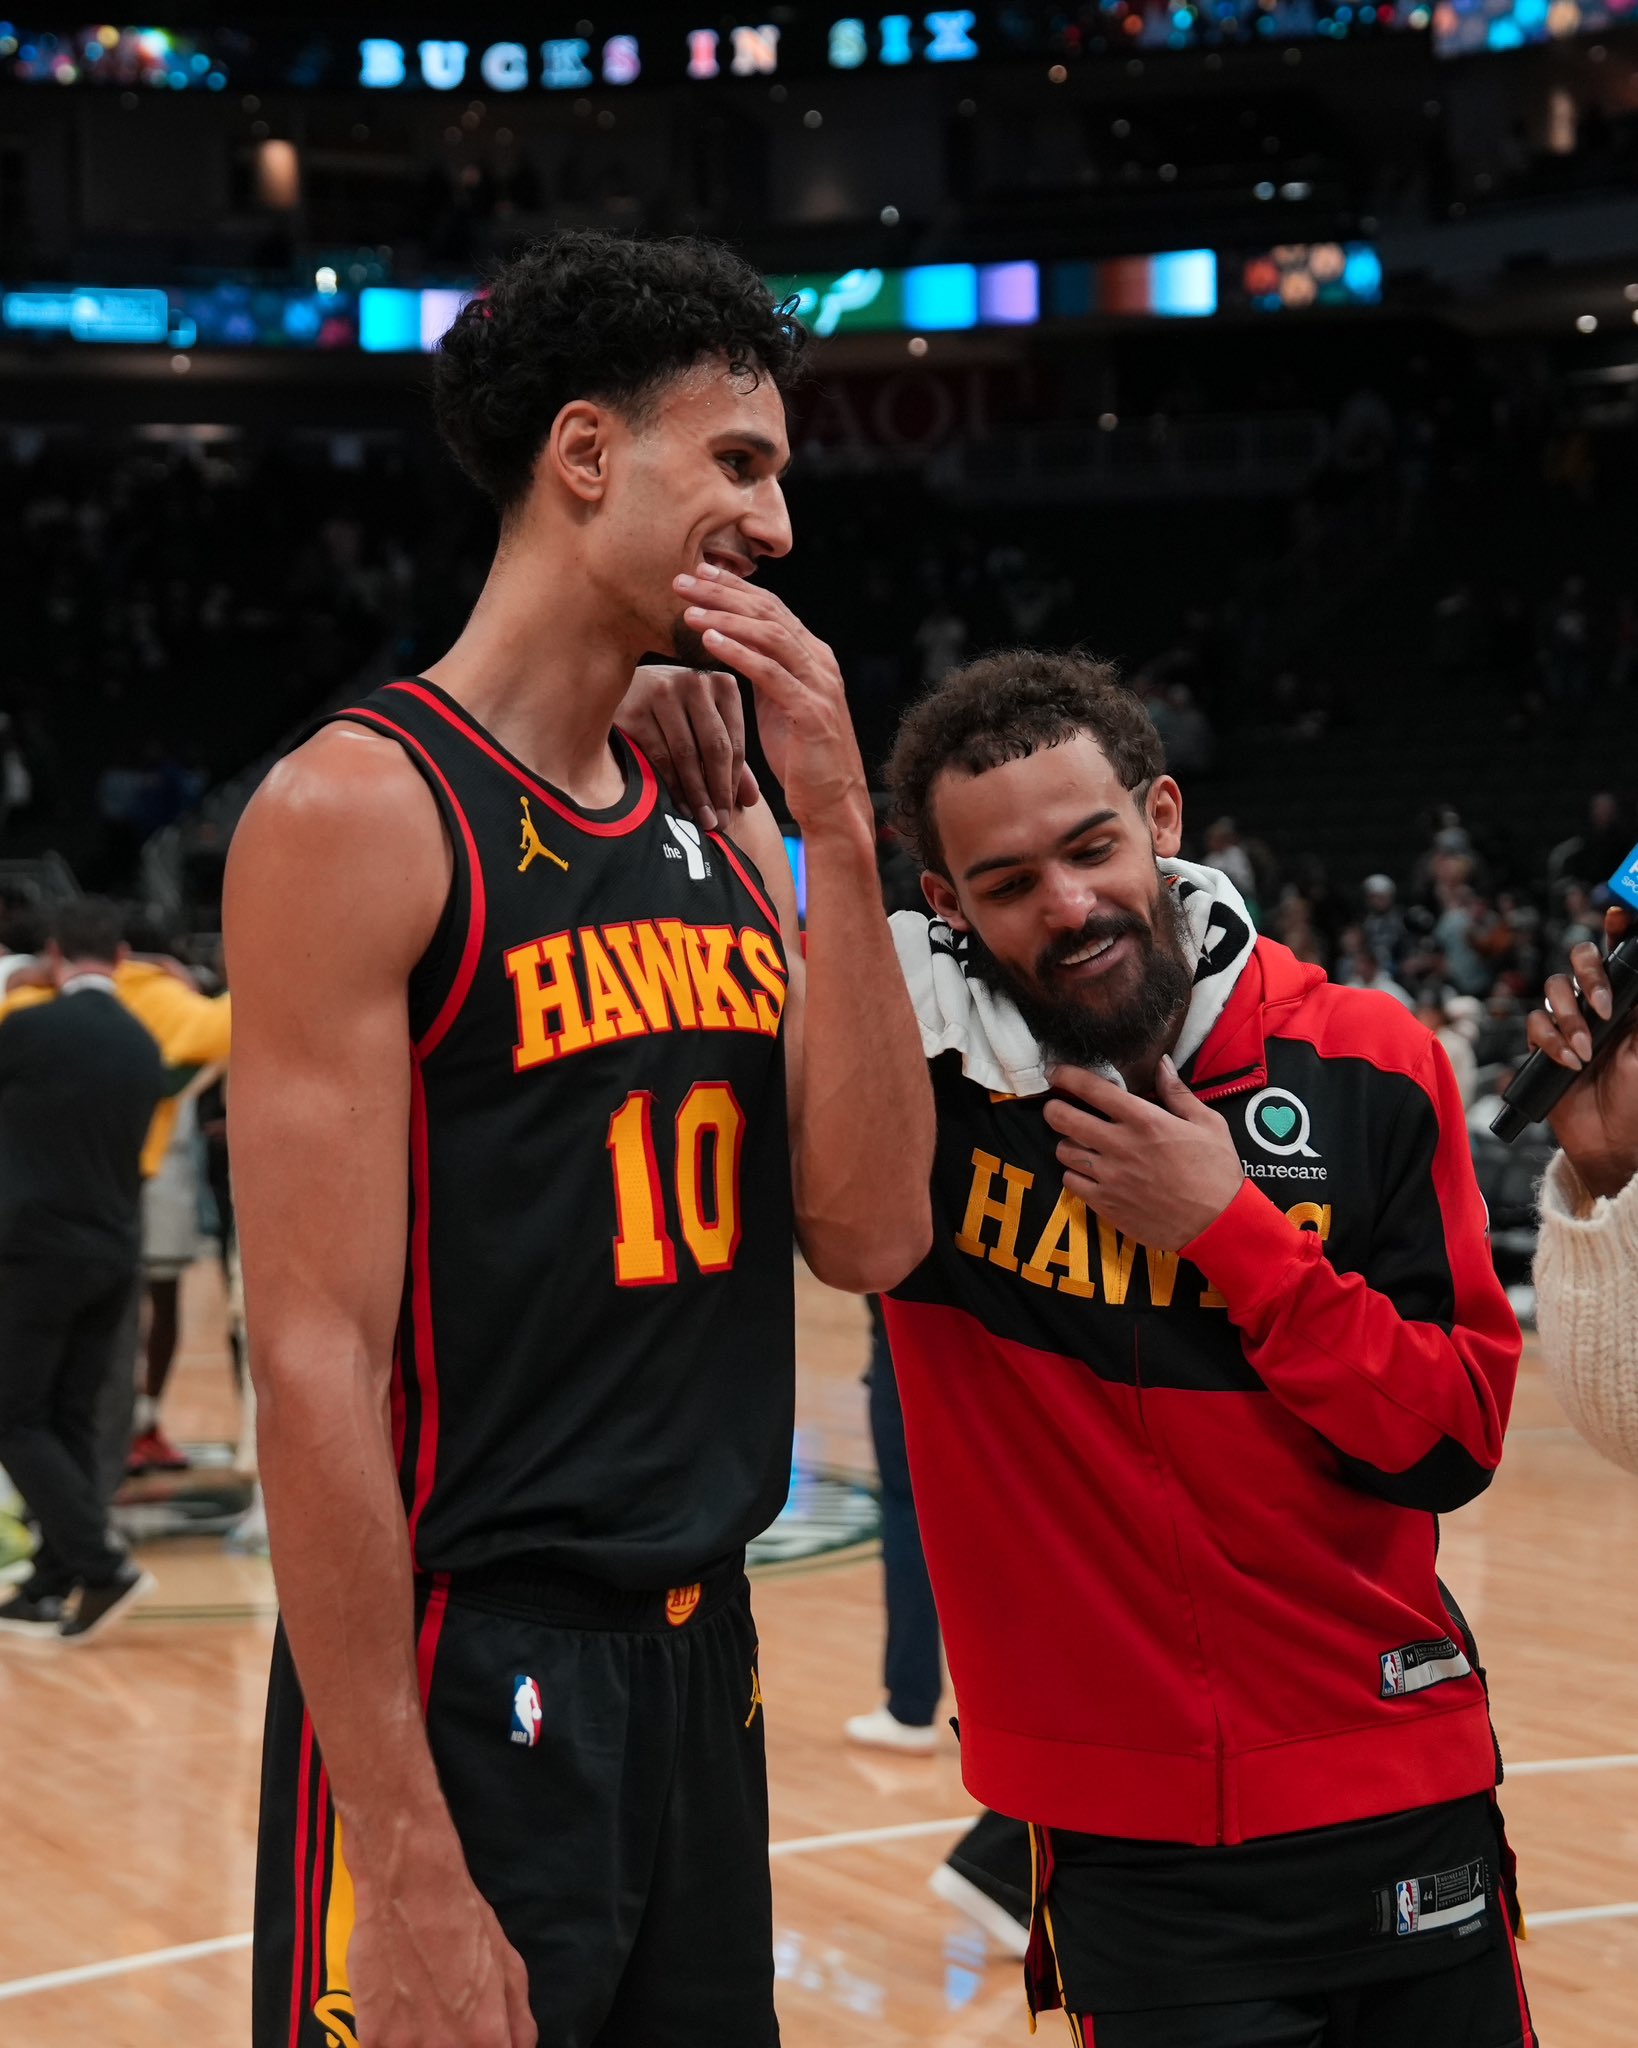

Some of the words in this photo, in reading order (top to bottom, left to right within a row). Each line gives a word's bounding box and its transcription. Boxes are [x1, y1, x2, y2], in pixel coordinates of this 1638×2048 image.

[359, 35, 641, 92] BUCKS
[687, 24, 780, 80] IN
[828, 10, 979, 69] SIX
[662, 843, 682, 859] the
[503, 917, 789, 1074] HAWKS
[606, 1080, 746, 1287] 10
[1241, 1159, 1328, 1180] harecare
[511, 1730, 528, 1742] NBA
